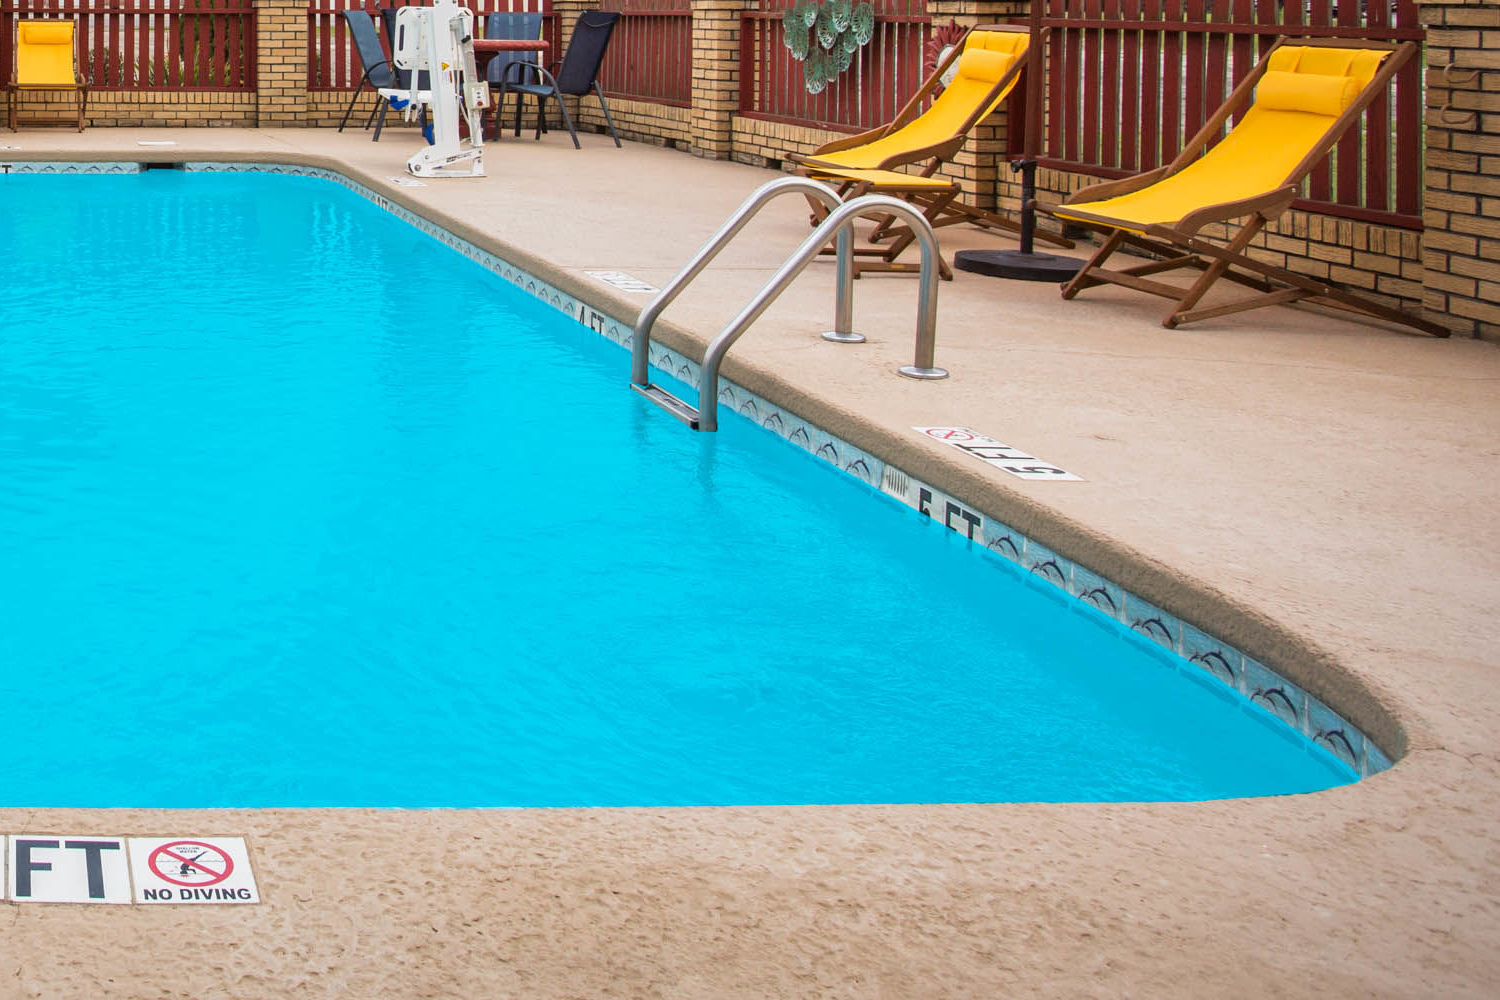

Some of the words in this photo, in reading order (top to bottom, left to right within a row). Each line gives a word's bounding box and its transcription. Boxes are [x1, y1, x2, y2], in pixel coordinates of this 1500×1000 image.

[15, 839, 120, 899] FT
[143, 888, 173, 901] NO
[180, 888, 252, 900] DIVING
